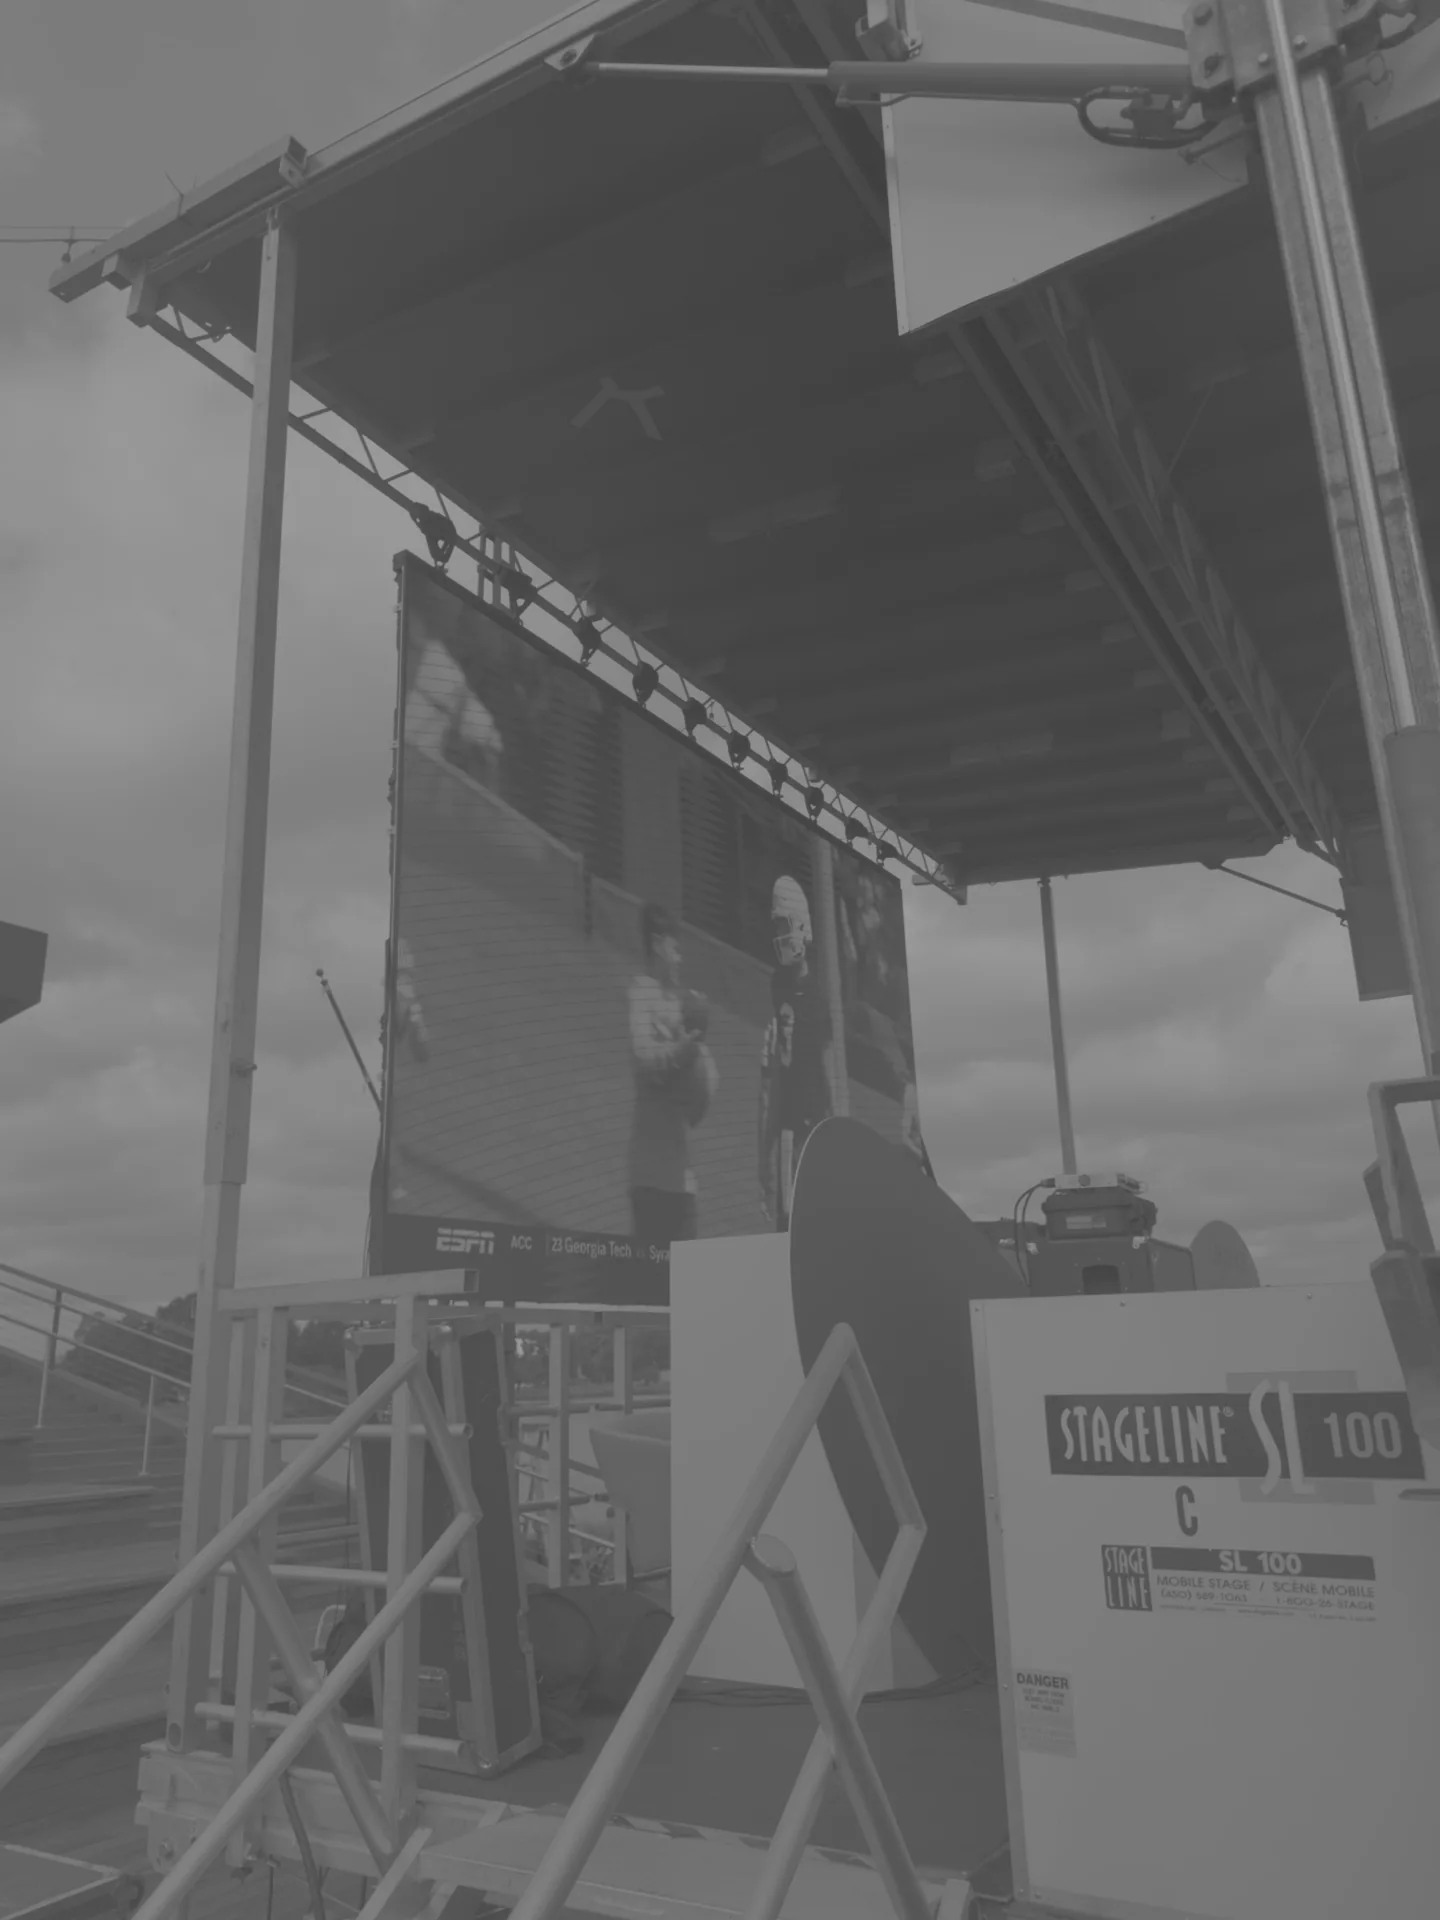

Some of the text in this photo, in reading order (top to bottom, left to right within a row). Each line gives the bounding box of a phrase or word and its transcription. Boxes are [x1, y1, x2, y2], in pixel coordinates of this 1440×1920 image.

[436, 1227, 495, 1255] ESPN
[511, 1235, 533, 1250] ACC
[551, 1237, 562, 1253] 23
[565, 1236, 606, 1259] Georgia
[609, 1240, 632, 1258] Tech
[1248, 1379, 1315, 1495] SL
[1324, 1411, 1402, 1460] 100
[1175, 1485, 1199, 1537] C
[1104, 1547, 1144, 1575] STAGE
[1219, 1550, 1303, 1575] SL 100
[1106, 1576, 1150, 1609] LINE
[1156, 1575, 1204, 1589] MOBILE
[1208, 1577, 1251, 1591] STAGE
[1322, 1584, 1375, 1598] MOBILE
[1017, 1673, 1069, 1690] DANGER
